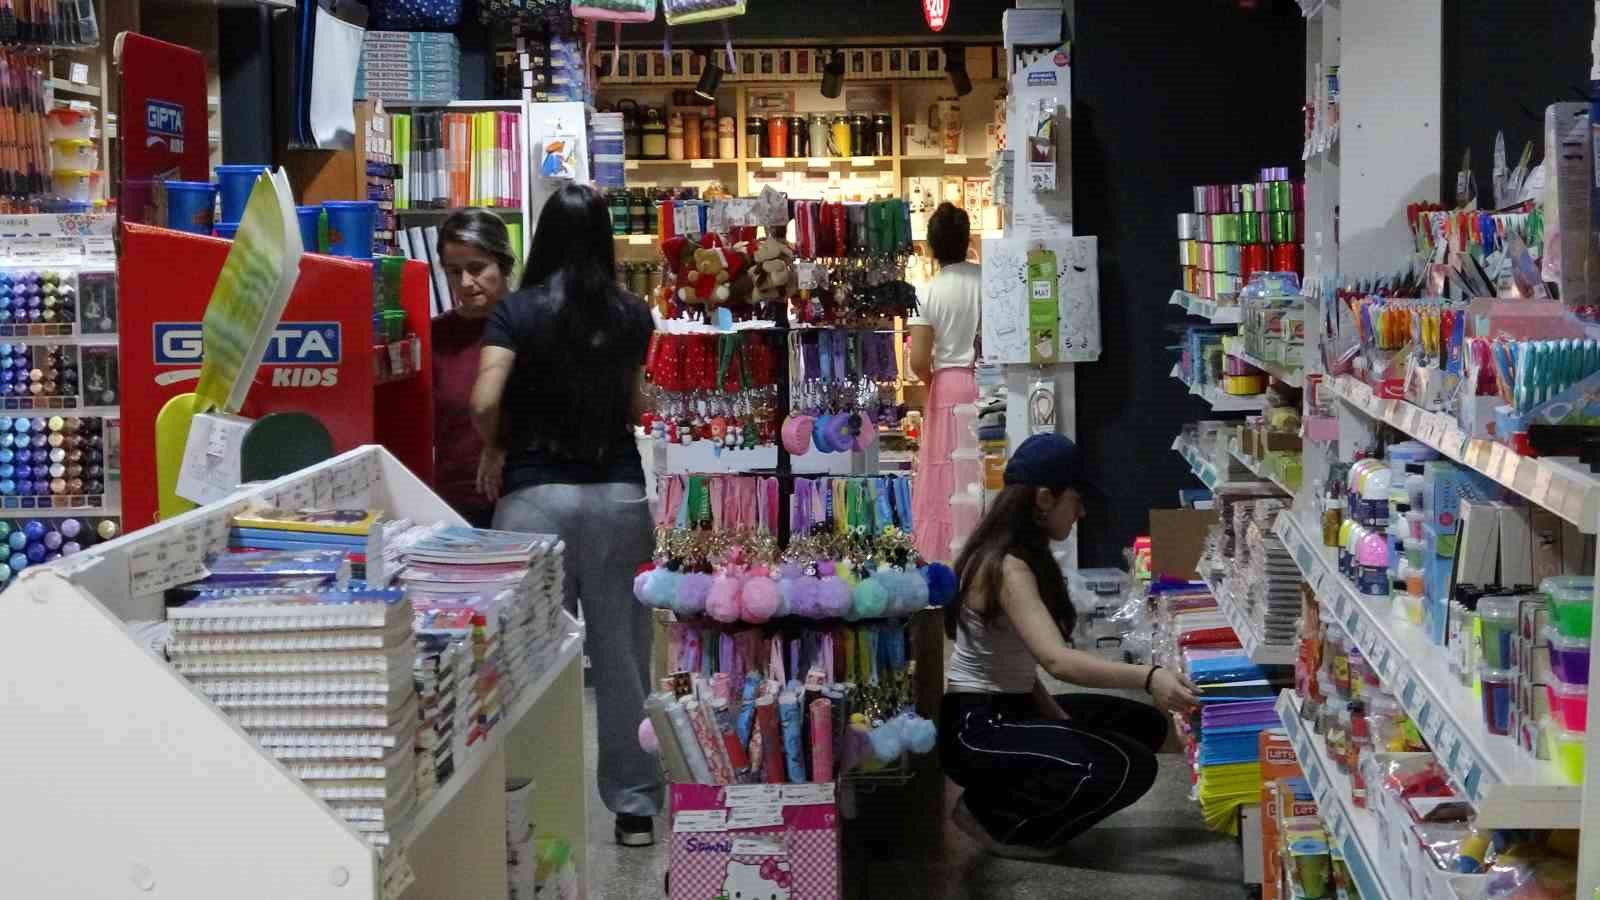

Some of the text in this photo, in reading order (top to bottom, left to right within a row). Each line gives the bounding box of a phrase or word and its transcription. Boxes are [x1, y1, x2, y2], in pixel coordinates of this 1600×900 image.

[148, 104, 183, 132] GIPTA
[162, 329, 333, 358] GTA
[272, 367, 338, 387] KIDS
